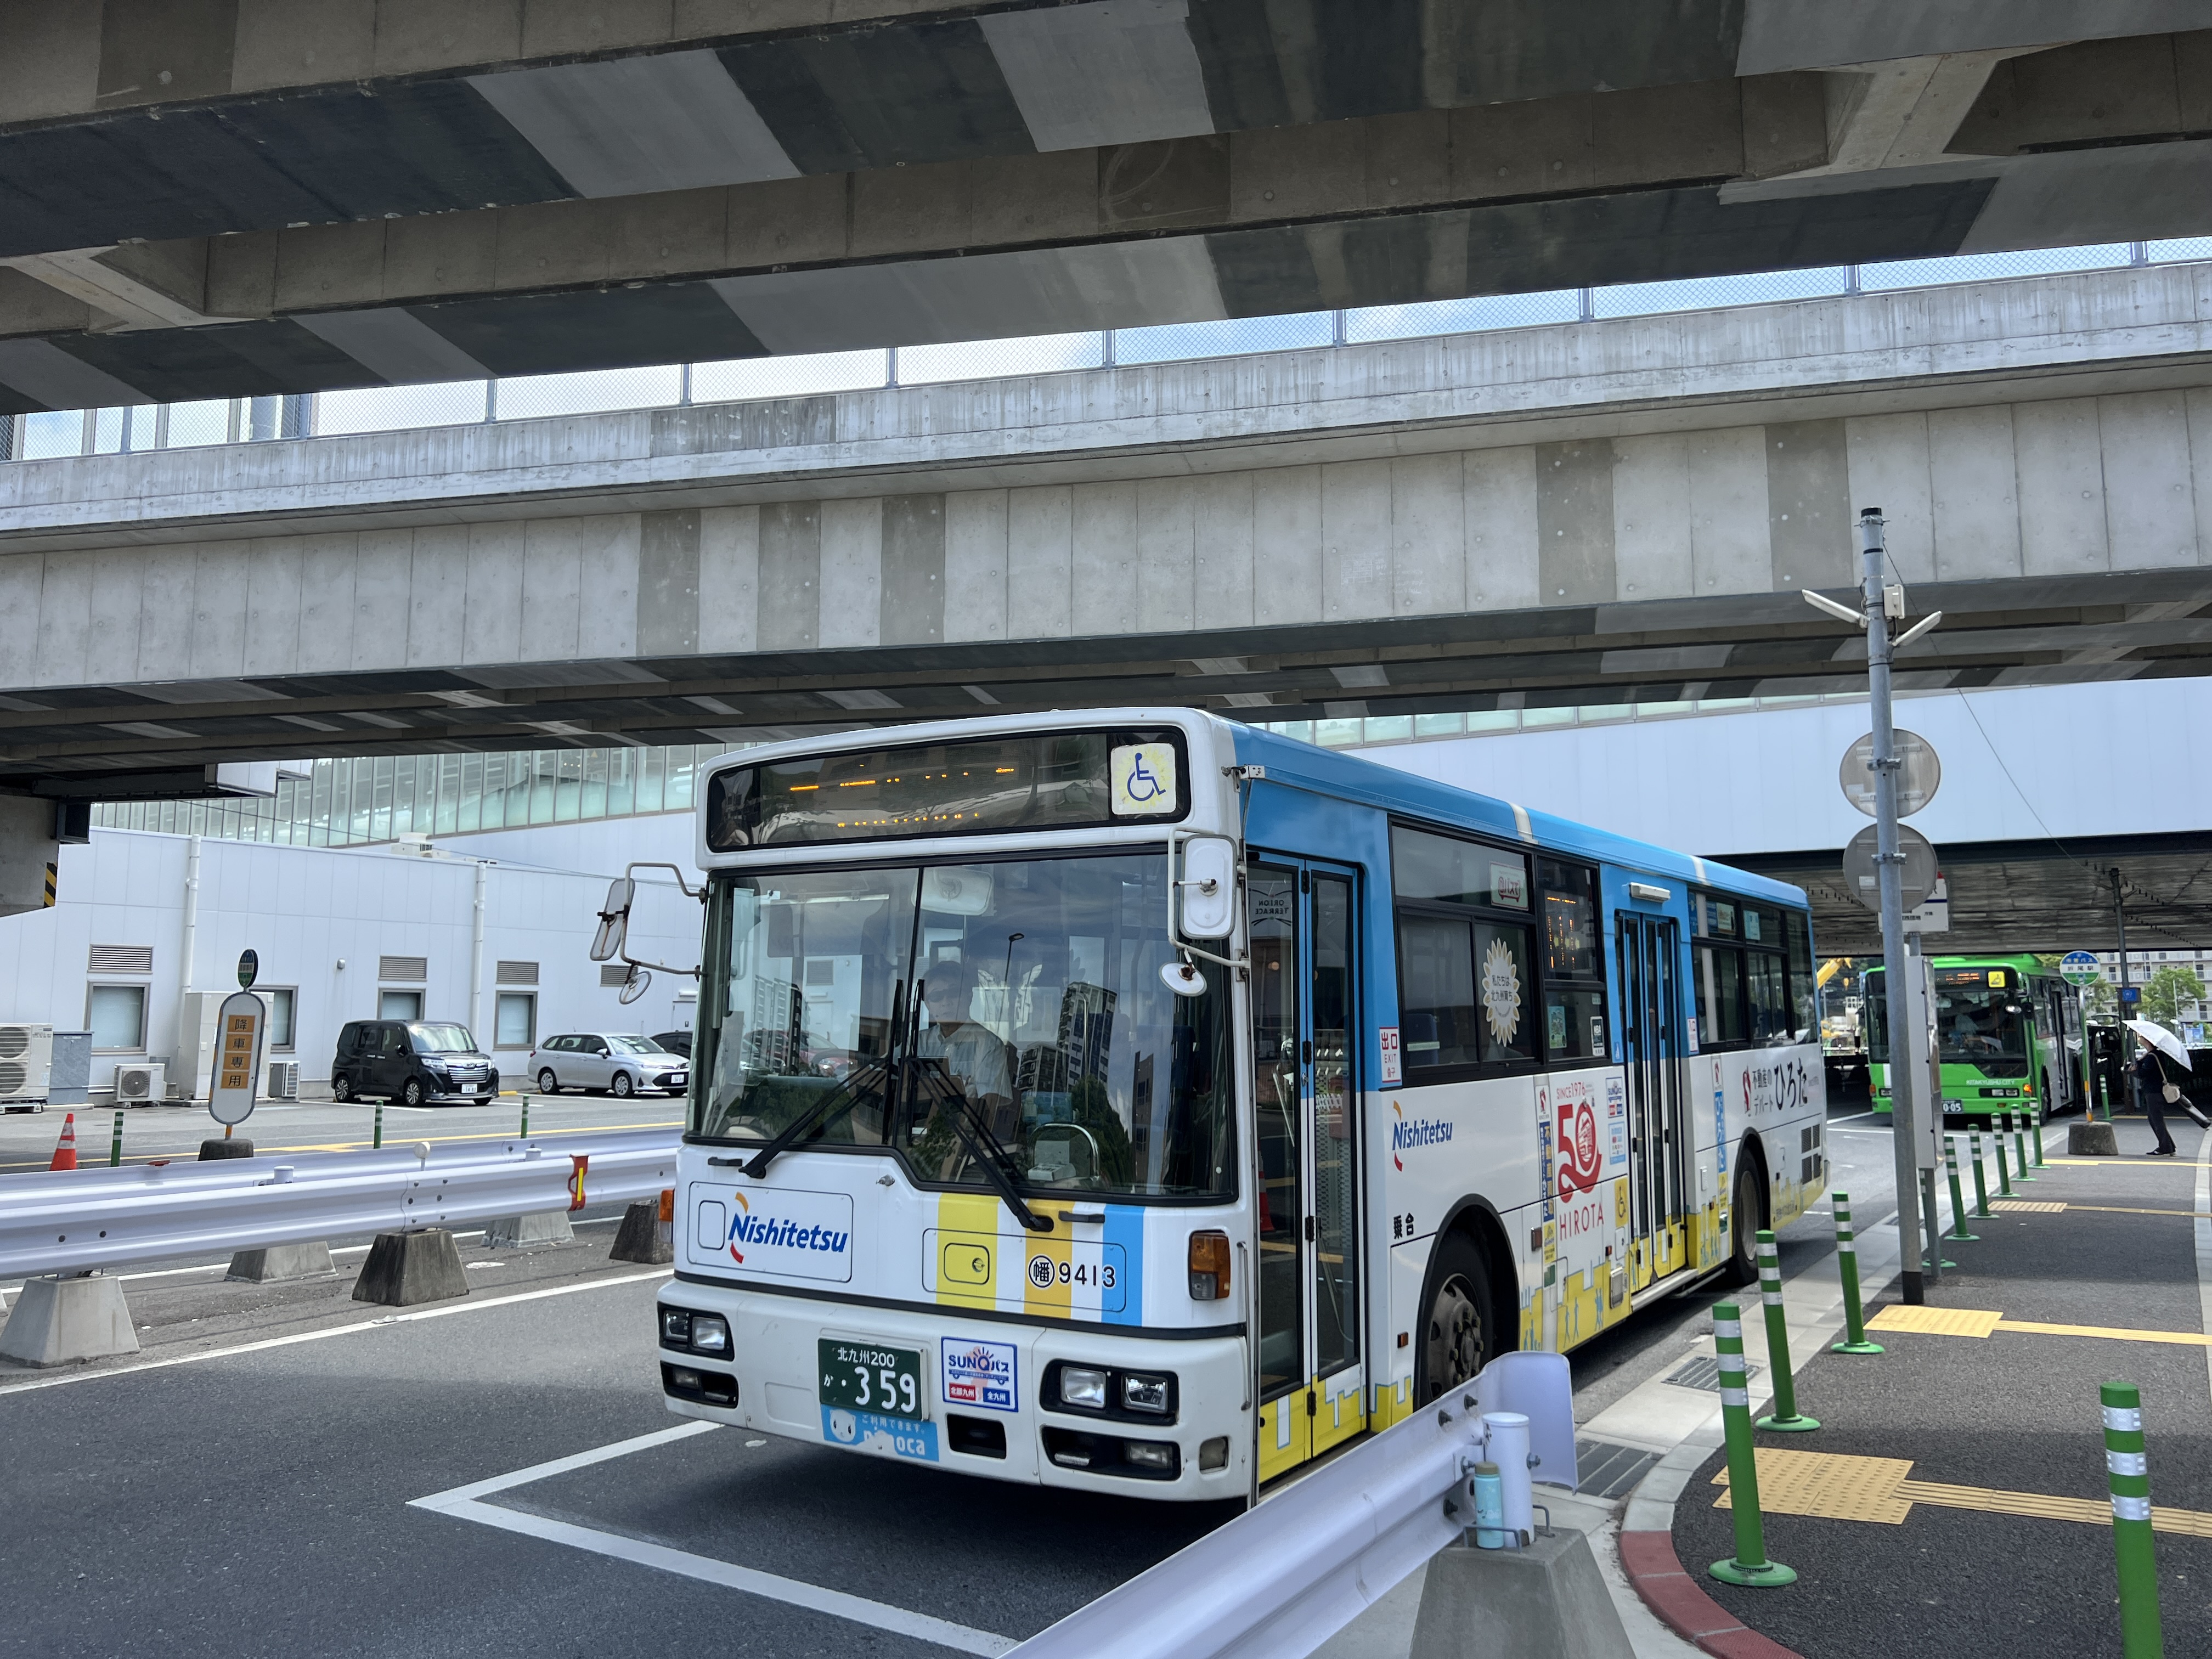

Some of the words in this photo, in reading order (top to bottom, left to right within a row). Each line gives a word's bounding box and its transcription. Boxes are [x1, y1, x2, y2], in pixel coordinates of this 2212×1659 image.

[228, 1019, 247, 1087] 降車専用
[1381, 1032, 1398, 1050] 出口
[1384, 1053, 1396, 1064] EXIT
[1392, 1119, 1453, 1151] Nishitetsu
[727, 1212, 849, 1252] Nishitetsu
[1393, 1212, 1414, 1239] 乗合
[1559, 1201, 1604, 1241] HIROTA
[1031, 1259, 1052, 1284] 幡
[1059, 1262, 1115, 1288] 9413
[950, 1386, 975, 1397] 北部九州
[987, 1391, 1006, 1403] 全九州
